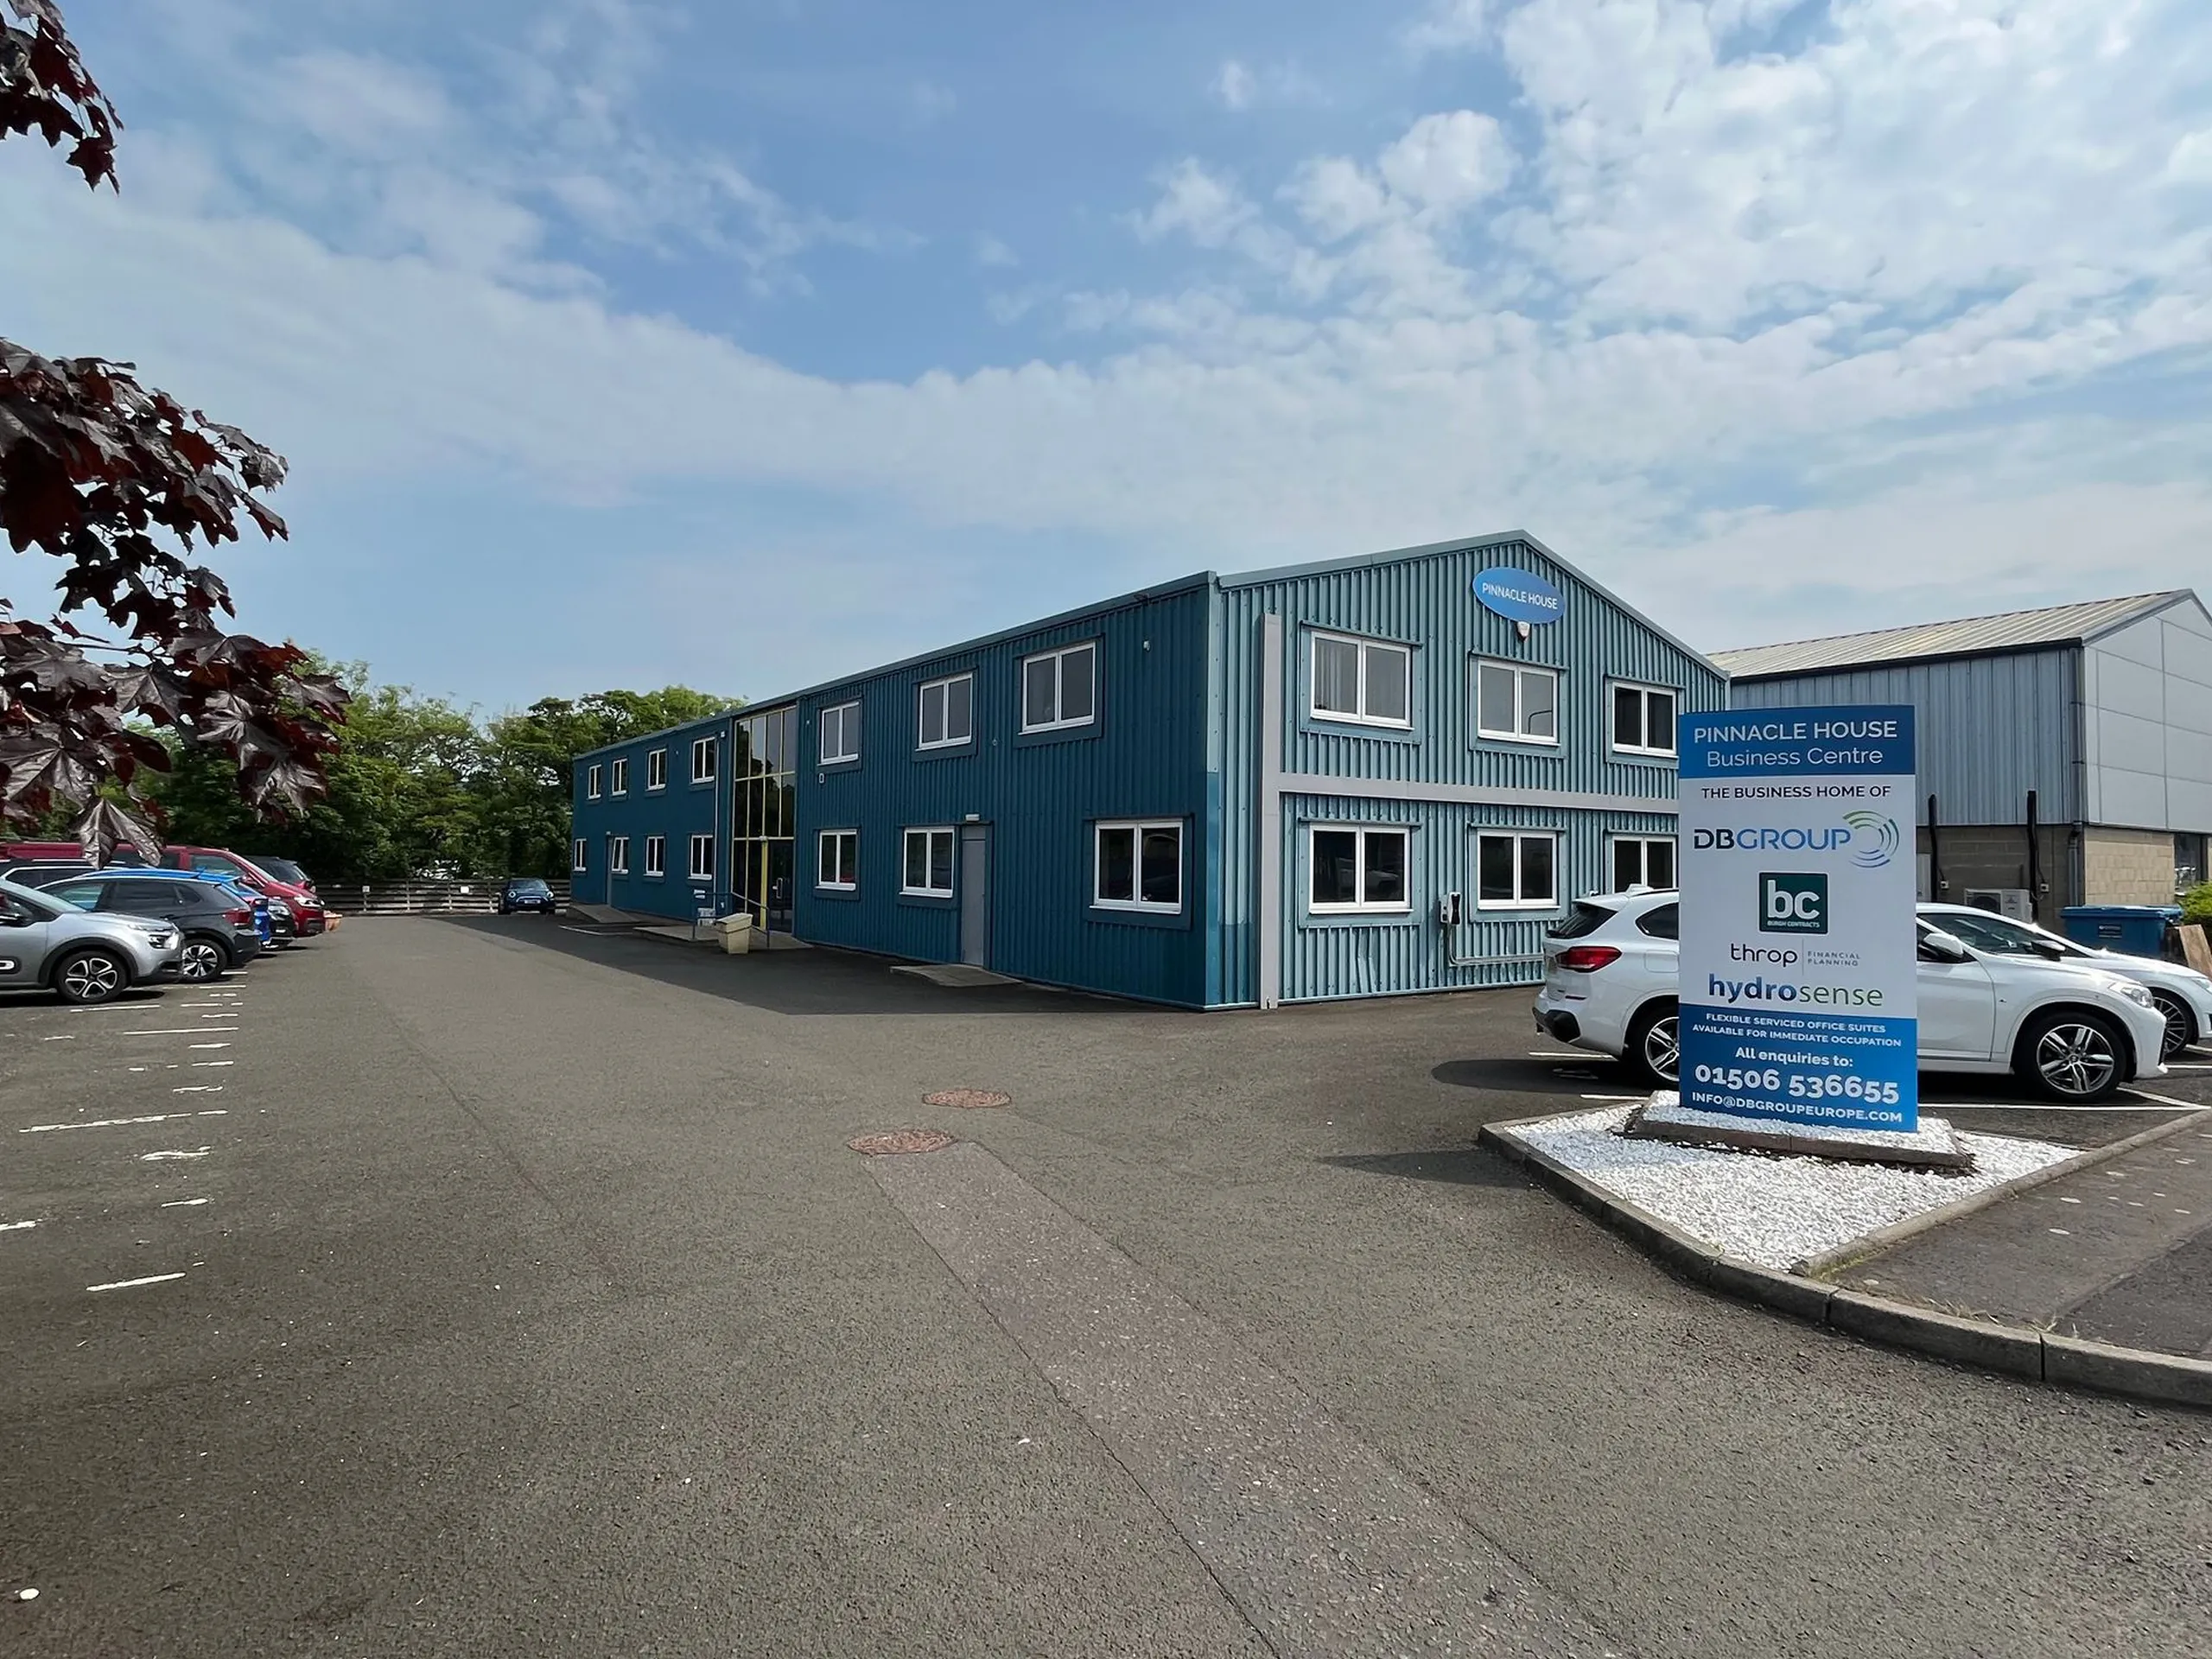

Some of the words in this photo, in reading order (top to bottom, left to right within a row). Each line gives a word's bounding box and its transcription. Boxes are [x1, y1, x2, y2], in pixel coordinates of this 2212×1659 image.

[1482, 582, 1527, 603] PINNACLE
[1528, 593, 1558, 610] HOUSE
[1694, 722, 1807, 744] PINNACLE
[1814, 720, 1897, 740] HOUSE
[1707, 750, 1801, 767] Business
[1807, 747, 1884, 765] Centre
[1701, 787, 1730, 799] THE
[1734, 786, 1812, 798] BUSINESS
[1816, 785, 1865, 798] HOME
[1869, 785, 1891, 798] OF
[1694, 829, 1852, 851] DBGROUP
[1767, 880, 1820, 919] bc
[1731, 943, 1798, 968] throp
[1808, 950, 1860, 960] FINANCIAL
[1708, 973, 1884, 1007] hydrosense
[1706, 1013, 1751, 1025] FLEXIBLE
[1753, 1017, 1805, 1028] SERVICED
[1807, 1021, 1846, 1031] OFFICE
[1848, 1024, 1886, 1033] SUITES
[1692, 1024, 1745, 1036] AVAILABLE
[1746, 1029, 1767, 1038] FOR
[1770, 1031, 1829, 1043] IMMEDIATE
[1831, 1036, 1902, 1047] OCCUPATION
[1735, 1046, 1756, 1059] All
[1758, 1051, 1830, 1065] enquiries
[1833, 1055, 1853, 1067] to:
[1694, 1065, 1781, 1090] 01506
[1789, 1074, 1900, 1104] 536655
[1692, 1091, 1903, 1122] INFO@DBGROUPEUROPE.COM
